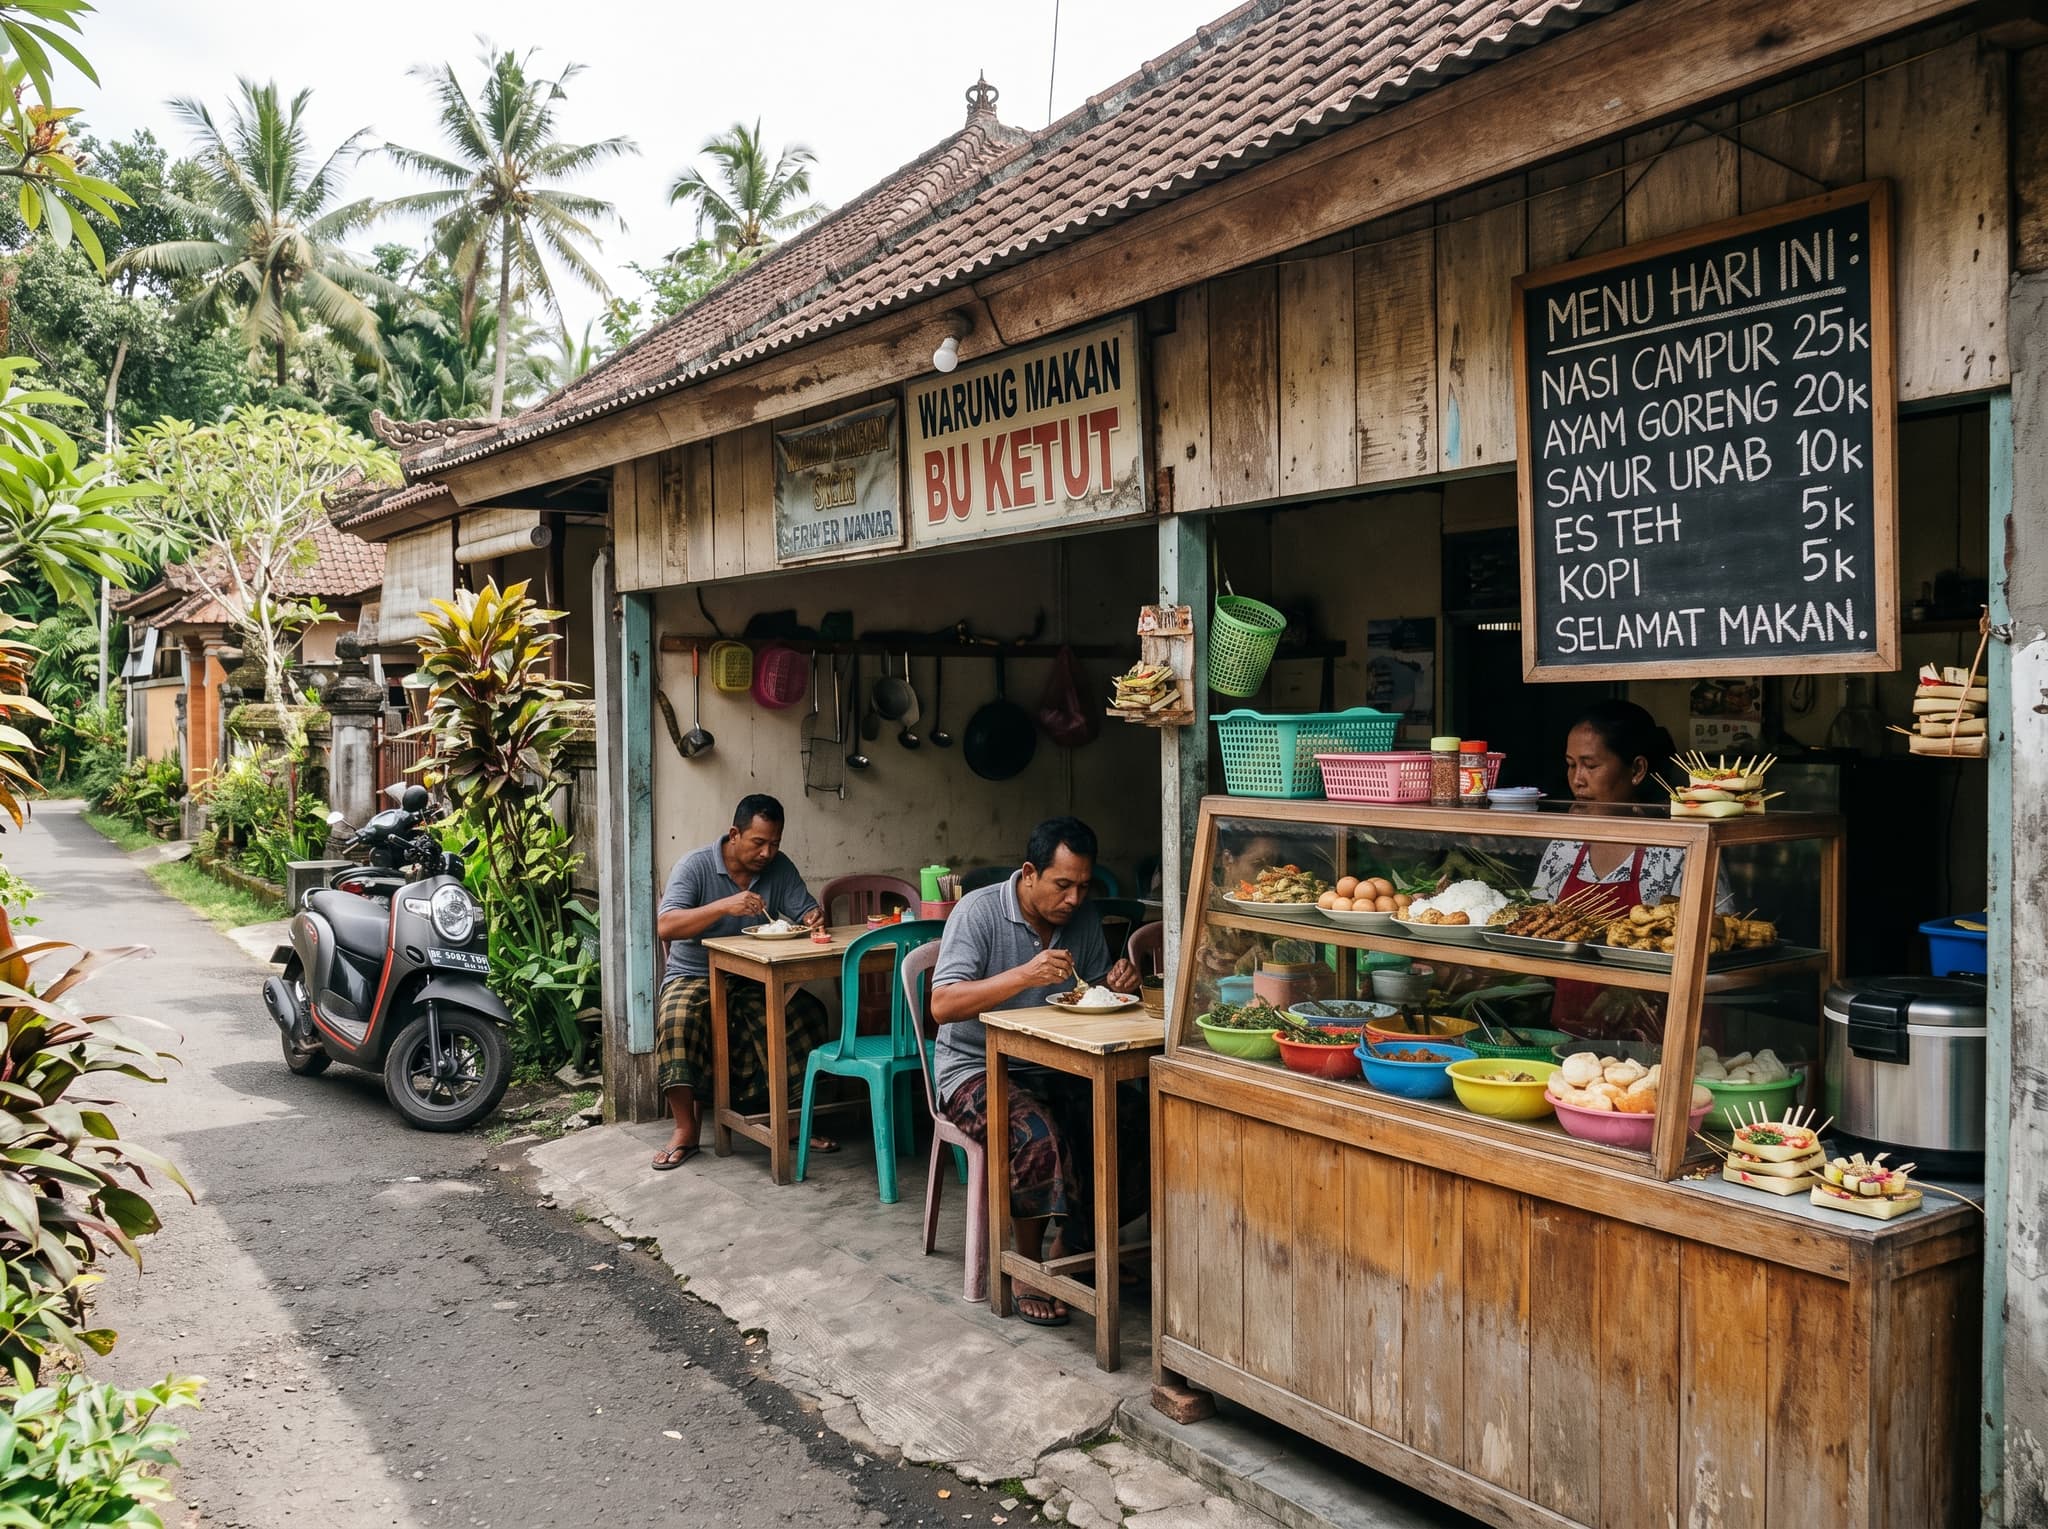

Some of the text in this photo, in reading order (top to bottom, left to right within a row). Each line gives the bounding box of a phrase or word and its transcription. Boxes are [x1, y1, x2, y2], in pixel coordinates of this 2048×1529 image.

[1548, 274, 1654, 342] MENU
[1671, 247, 1760, 315] HARI
[918, 337, 1121, 439] WARUNG MAKAN
[1541, 306, 1869, 410] NASI CAMPUR 25k
[1544, 371, 1869, 459] AYAM GORENG 20k
[924, 442, 973, 525] BU
[982, 406, 1121, 514] KETUT
[1547, 429, 1864, 509] SAYUR URAB 10k
[1555, 485, 1856, 555] ES TEH 5k
[1560, 538, 1856, 604] KOPI 5k
[1556, 598, 1868, 654] SELAMAT MAKAN.
